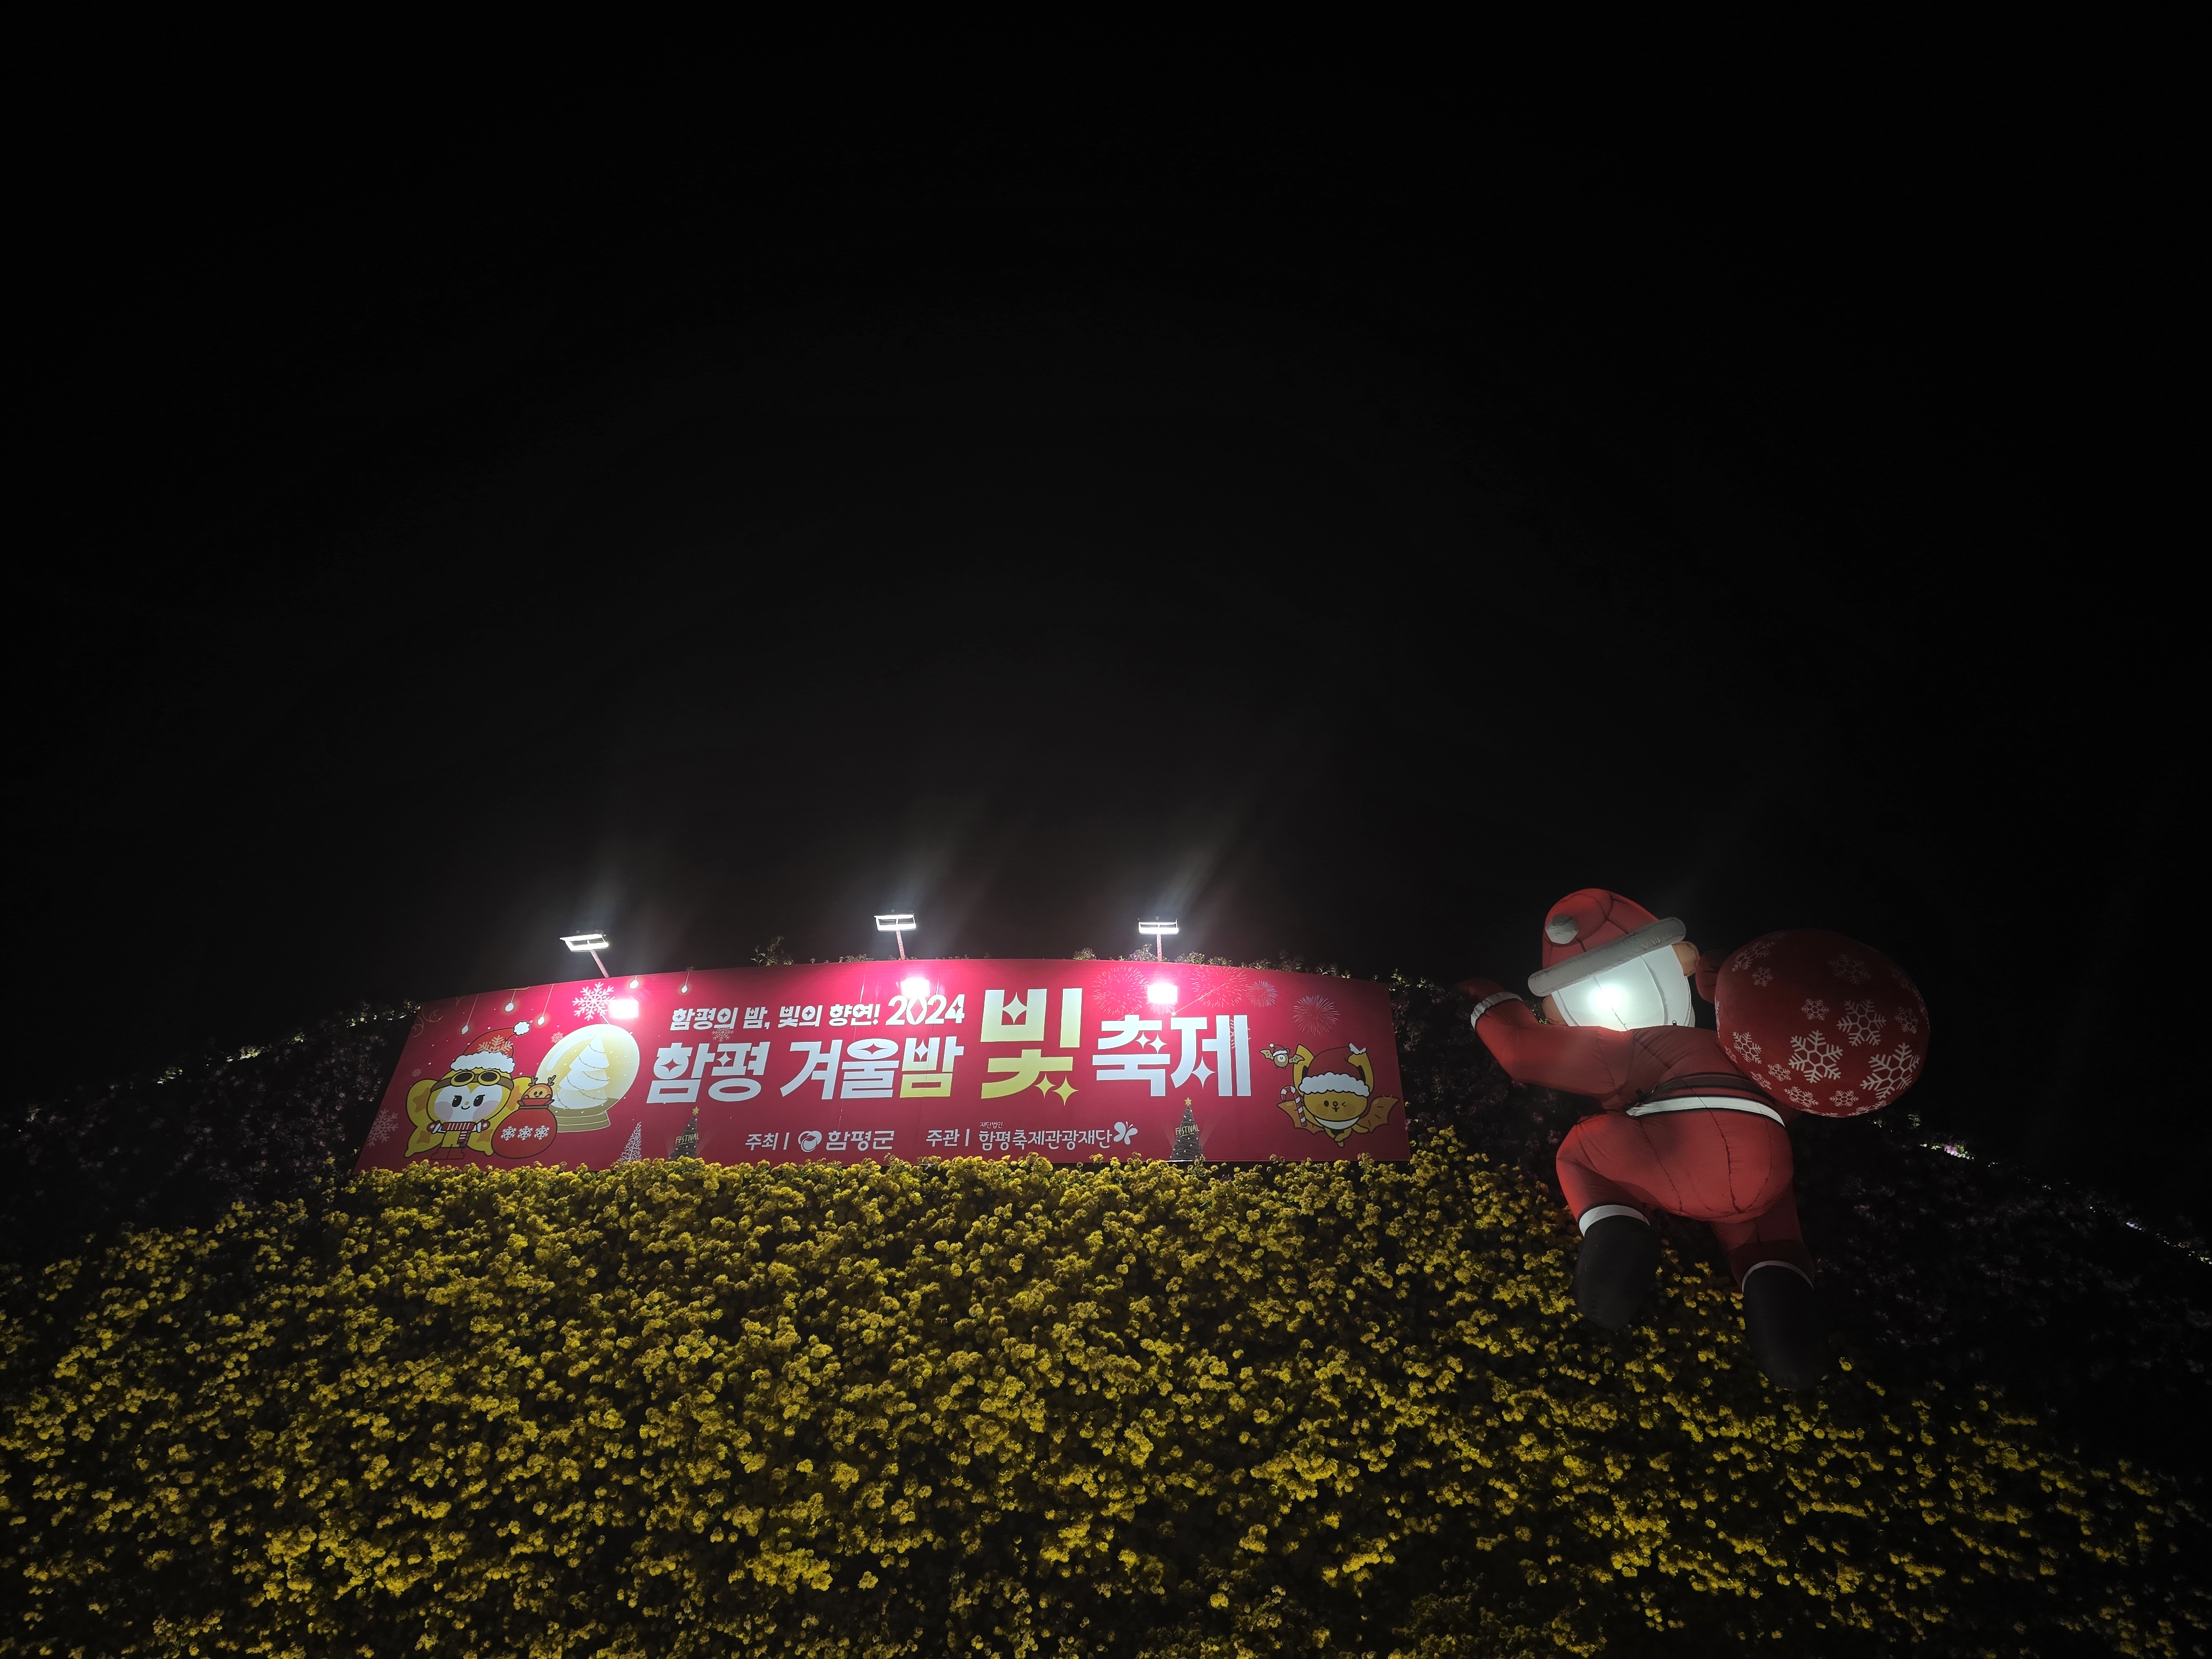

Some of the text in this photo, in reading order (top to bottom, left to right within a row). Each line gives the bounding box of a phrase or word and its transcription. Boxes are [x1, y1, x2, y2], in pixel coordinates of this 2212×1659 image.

[670, 994, 966, 1030] 함평의 밤, 빛의 향연! 2024
[646, 988, 1251, 1106] 함평 겨울밤 빛 축제
[979, 1121, 1004, 1129] 재단법인
[745, 1130, 895, 1151] 주최 함평군
[926, 1129, 1113, 1151] 주관 함평축제관광재단
